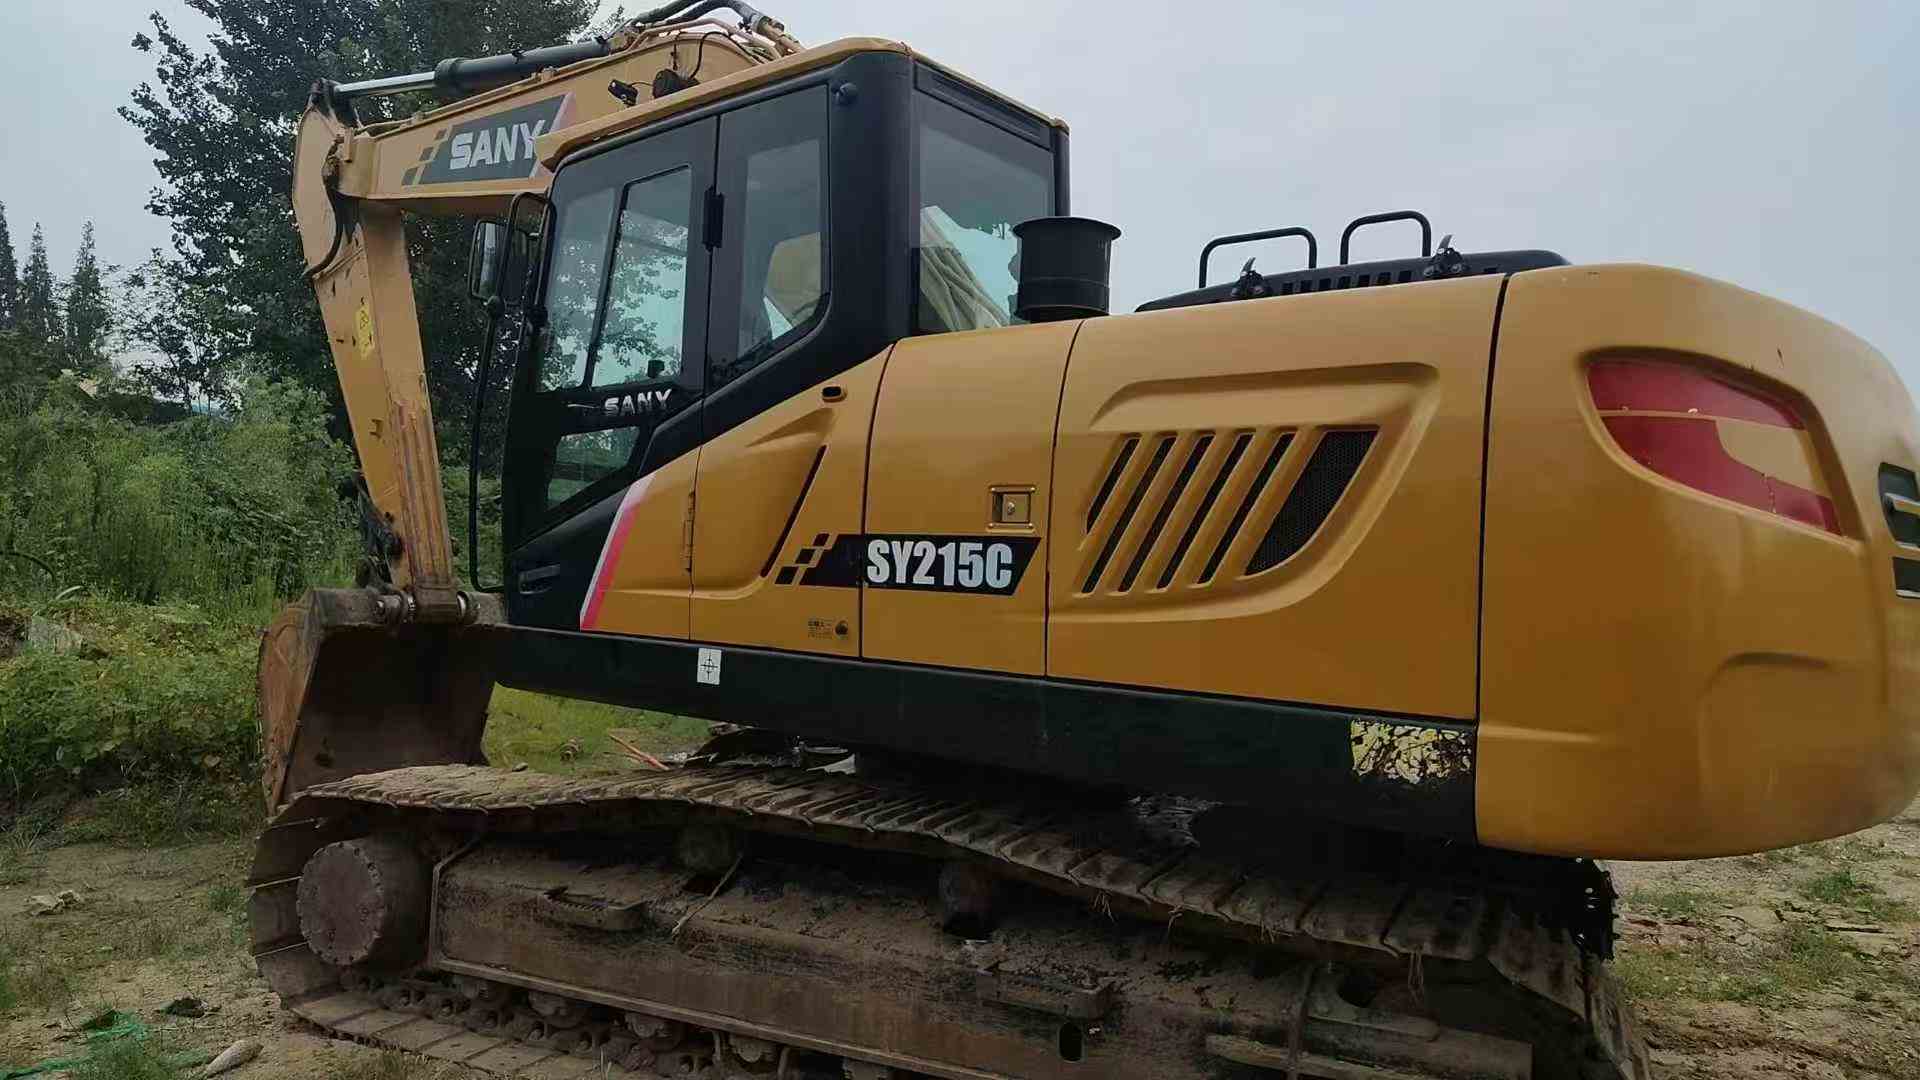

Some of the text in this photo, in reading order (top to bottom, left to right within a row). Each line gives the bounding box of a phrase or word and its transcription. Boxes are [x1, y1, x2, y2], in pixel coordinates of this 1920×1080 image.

[449, 119, 546, 170] SANY
[604, 388, 672, 415] SANY
[866, 539, 1013, 589] SY215C
